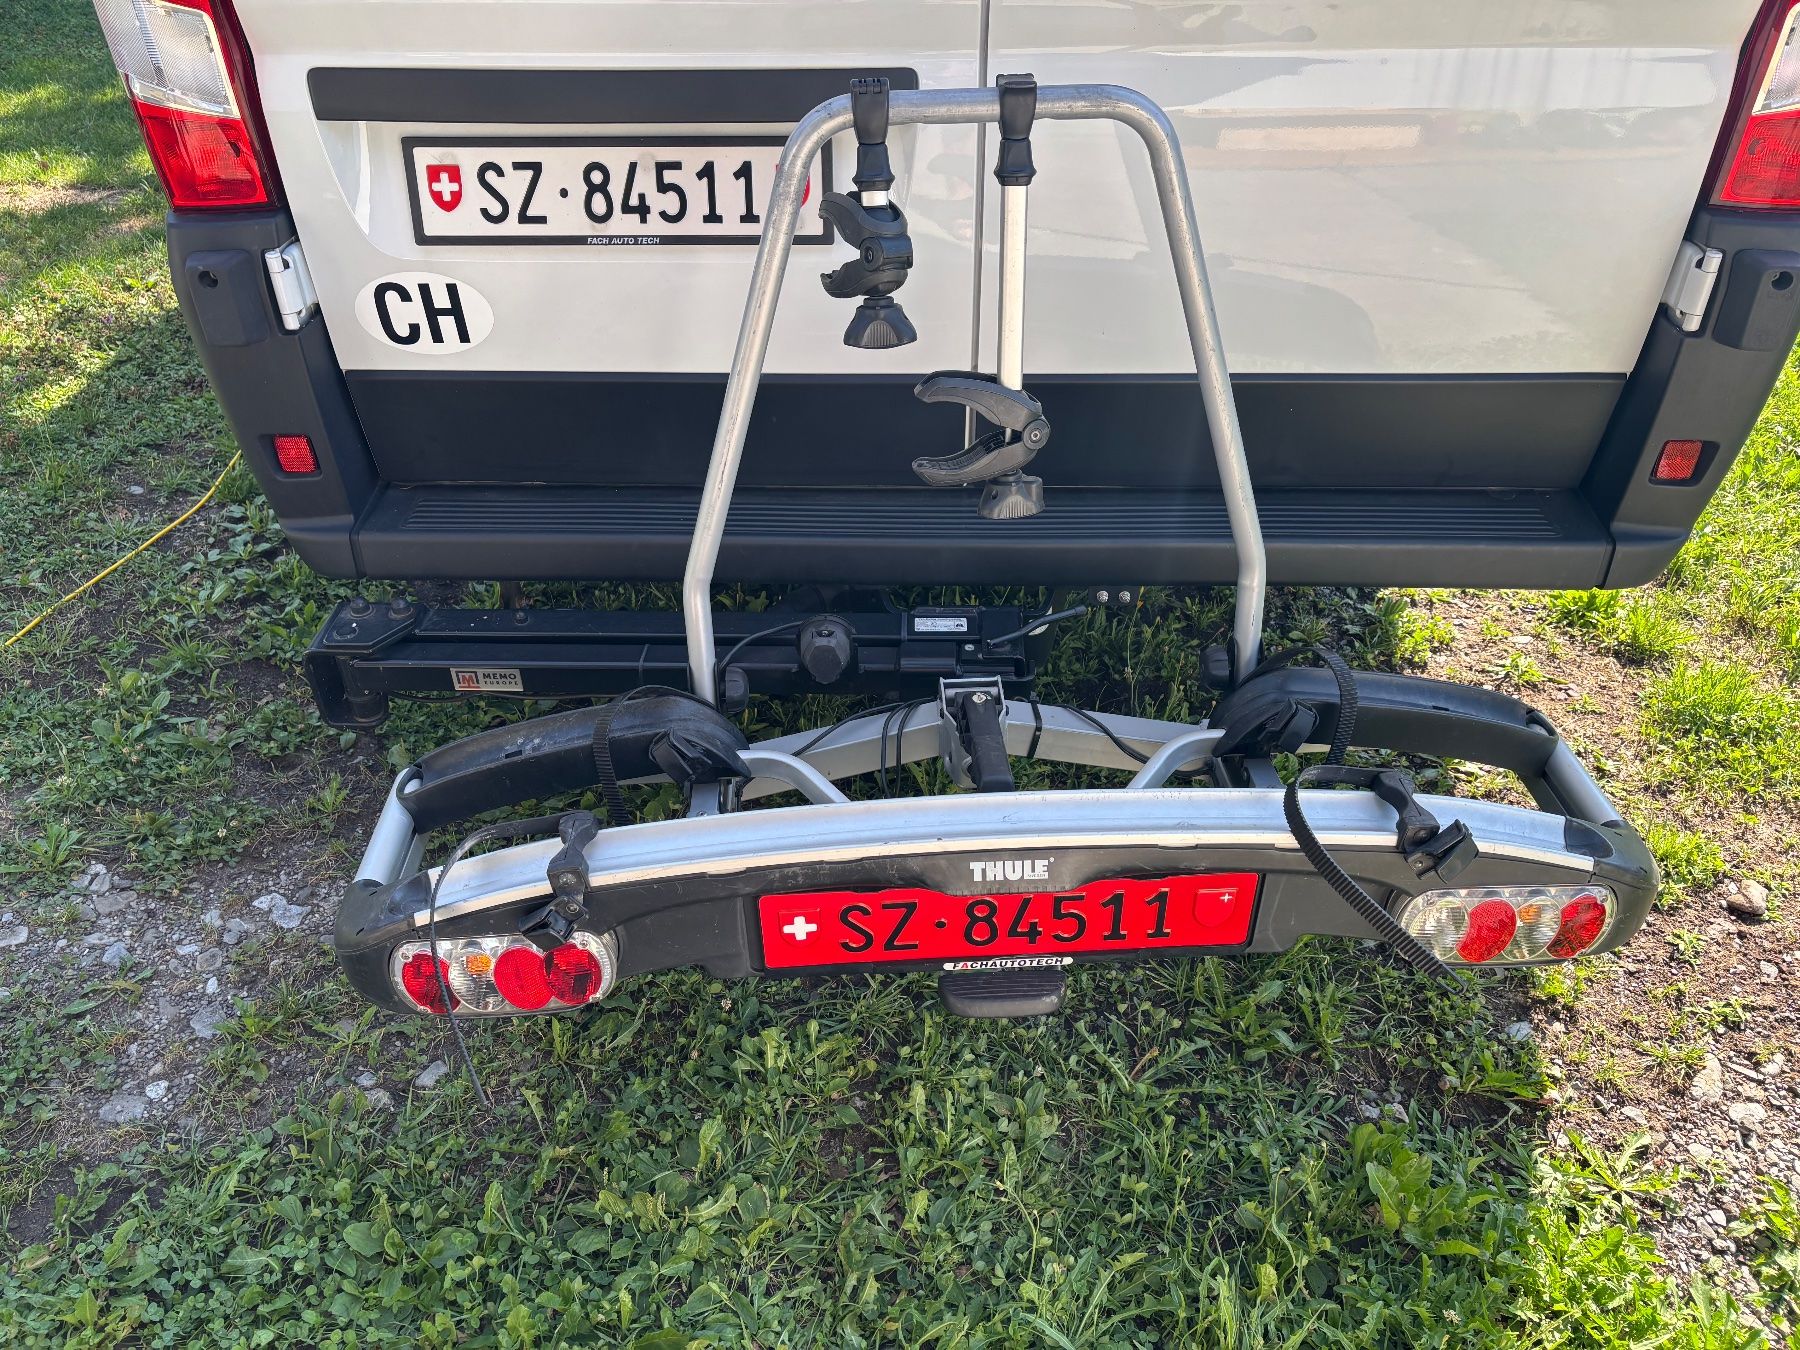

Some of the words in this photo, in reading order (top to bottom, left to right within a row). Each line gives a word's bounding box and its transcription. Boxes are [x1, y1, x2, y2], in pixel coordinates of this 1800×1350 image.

[373, 282, 471, 344] CH
[969, 859, 1049, 882] THULE
[952, 958, 1064, 970] FACHAUTOTECH
